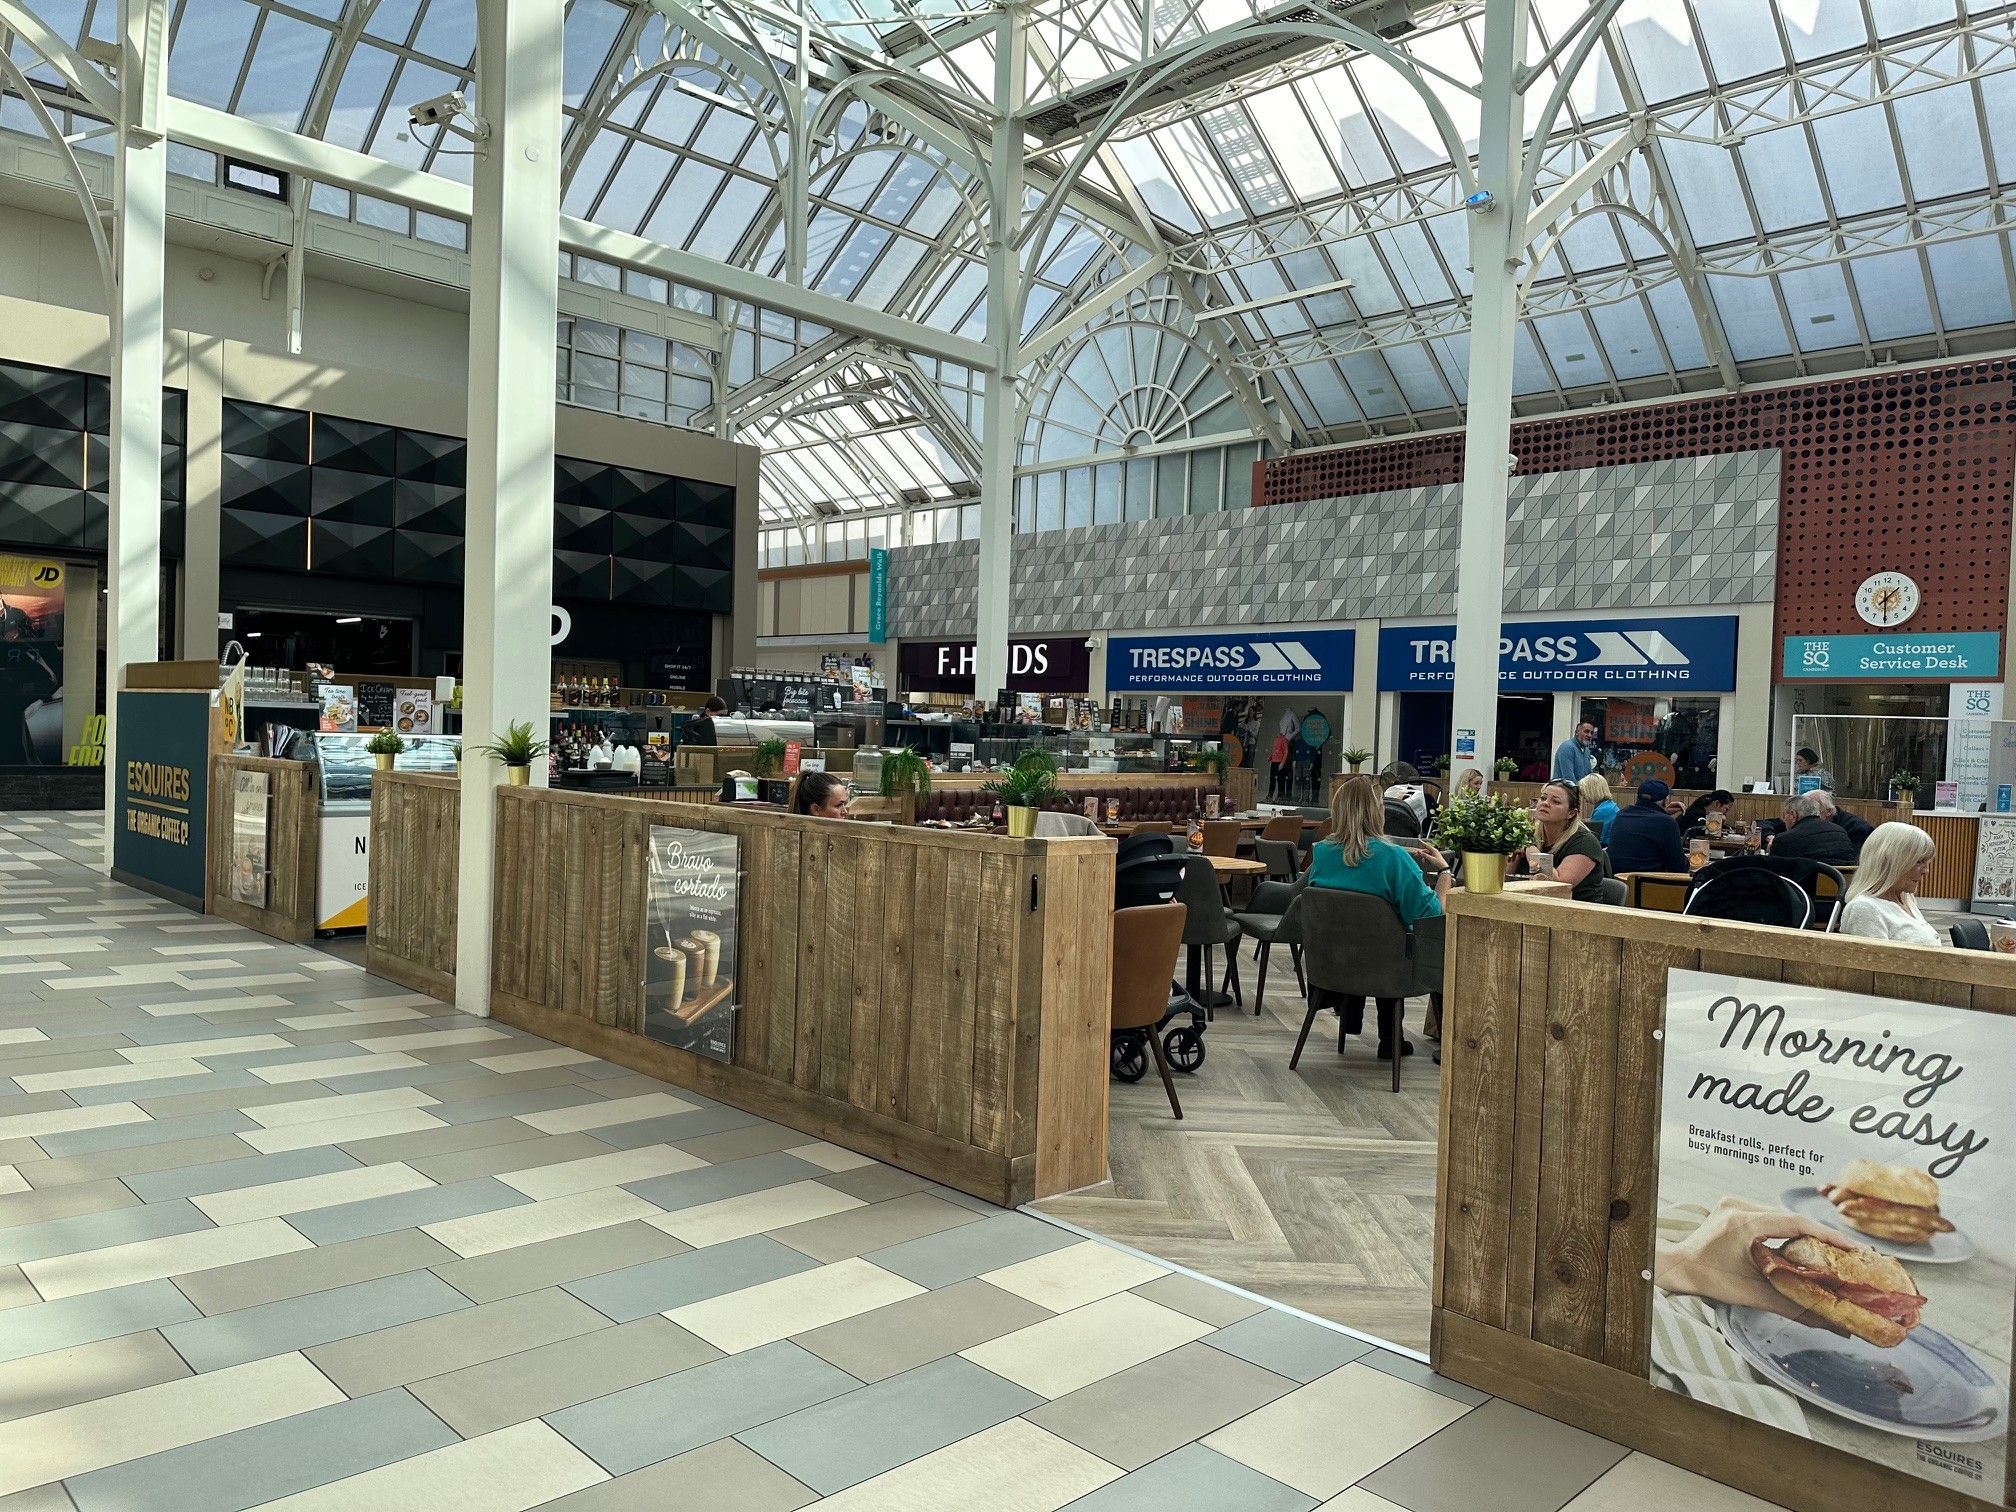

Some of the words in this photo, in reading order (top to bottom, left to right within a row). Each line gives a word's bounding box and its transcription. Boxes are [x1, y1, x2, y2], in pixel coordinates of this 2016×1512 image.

[34, 566, 60, 581] JD
[1129, 646, 1245, 668] TRESPASS
[1803, 642, 1830, 650] THE
[1873, 642, 1955, 655] Customer
[938, 643, 1048, 675] F.HDS
[1802, 651, 1830, 667] SQ
[1859, 657, 1921, 669] Service
[1925, 655, 1968, 669] Desk
[1129, 674, 1203, 682] PERFORMANCE
[1206, 674, 1259, 682] OUTDOOR
[1262, 673, 1321, 682] CLOTHING
[1522, 670, 1598, 679] OUTDOOR
[1604, 670, 1690, 679] CLOTHING
[1966, 690, 1991, 698] THE
[1966, 698, 1991, 712] SQ
[127, 760, 190, 801] ESQUIRES
[127, 808, 137, 831] THE
[137, 810, 160, 838] ORGANIC
[161, 816, 180, 843] COFFEE
[667, 841, 714, 872] Bravo
[354, 882, 367, 891] ICE
[674, 873, 728, 901] cortado
[1707, 996, 1963, 1108] Morning
[1687, 1069, 1835, 1123] made
[1849, 1105, 1989, 1179] easy
[1689, 1124, 1736, 1144] Breakfast
[1768, 1143, 1805, 1159] perfect
[1809, 1150, 1825, 1163] for
[1688, 1138, 1711, 1154] busy
[1714, 1145, 1760, 1164] mornings
[1763, 1156, 1775, 1166] on
[1779, 1158, 1795, 1171] the
[1798, 1165, 1815, 1176] go.
[1916, 1440, 1983, 1470] ESQUIRES
